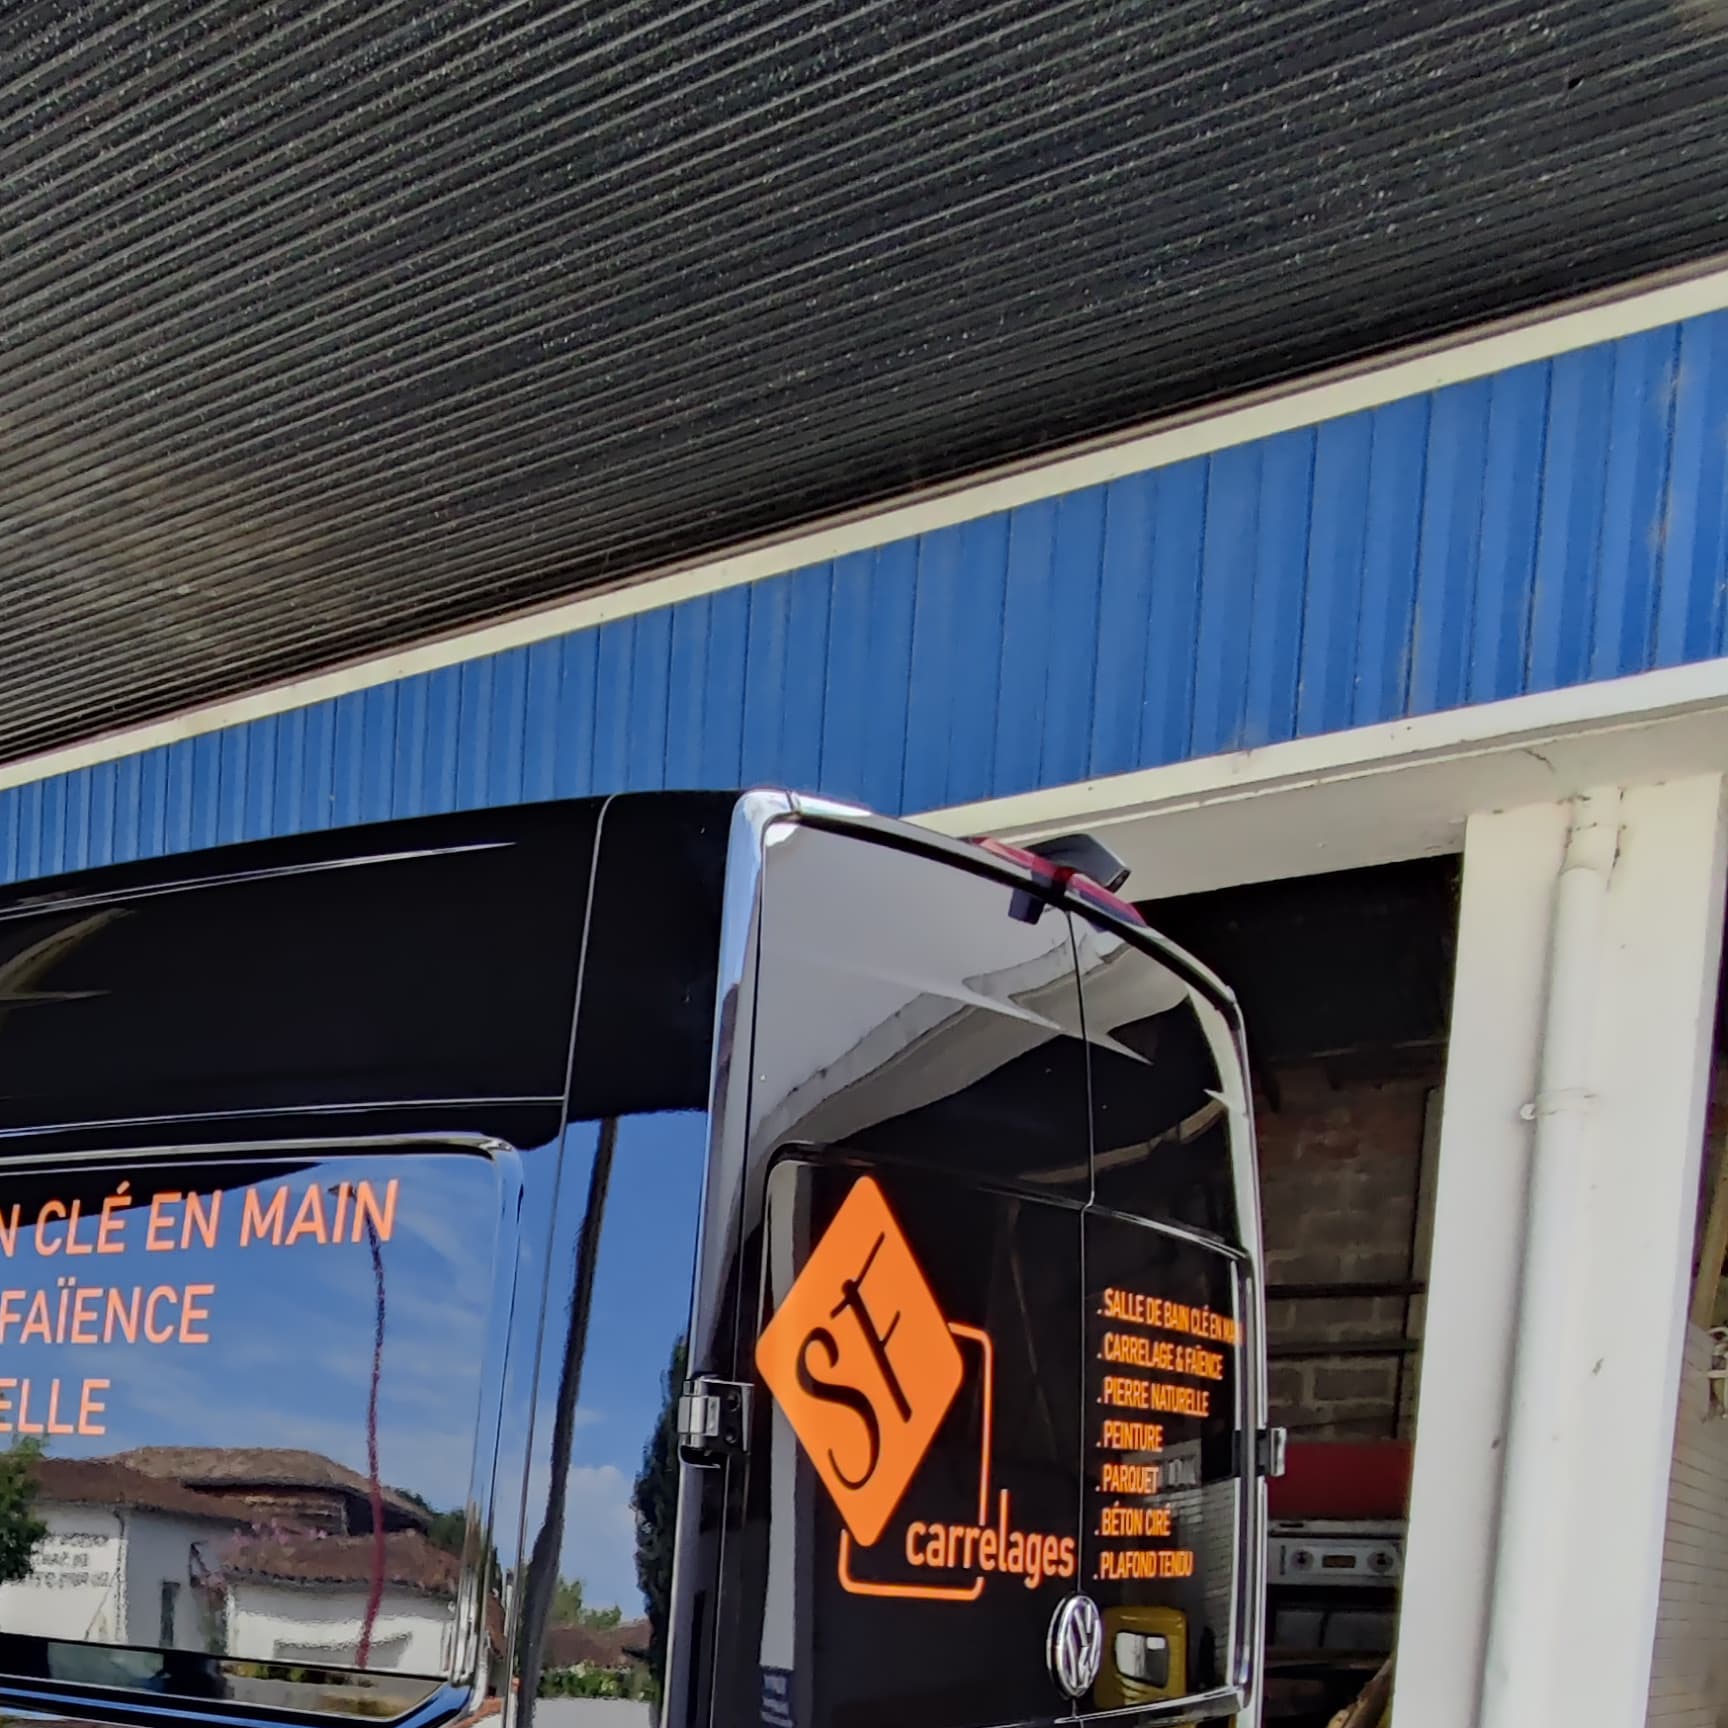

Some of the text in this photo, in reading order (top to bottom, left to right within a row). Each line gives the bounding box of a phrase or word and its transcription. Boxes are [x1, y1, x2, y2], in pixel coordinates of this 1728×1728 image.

[35, 1182, 131, 1257] CLÉ
[145, 1188, 223, 1253] EN
[239, 1178, 400, 1248] MAIN
[1104, 1288, 1145, 1322] SALLE
[1146, 1297, 1162, 1326] DE
[1164, 1301, 1189, 1333] BAIN
[1104, 1331, 1174, 1371] CARRELAGE
[1175, 1345, 1184, 1372] &
[1103, 1376, 1209, 1417] PIERRE NATURELLE
[1103, 1420, 1163, 1453] PEINTURE
[1103, 1464, 1159, 1495] PARQUET
[906, 1488, 1076, 1589] carrelages
[1101, 1500, 1171, 1537] BÉTON CIRÉ
[1100, 1550, 1193, 1581] PLAFOND TENDU
